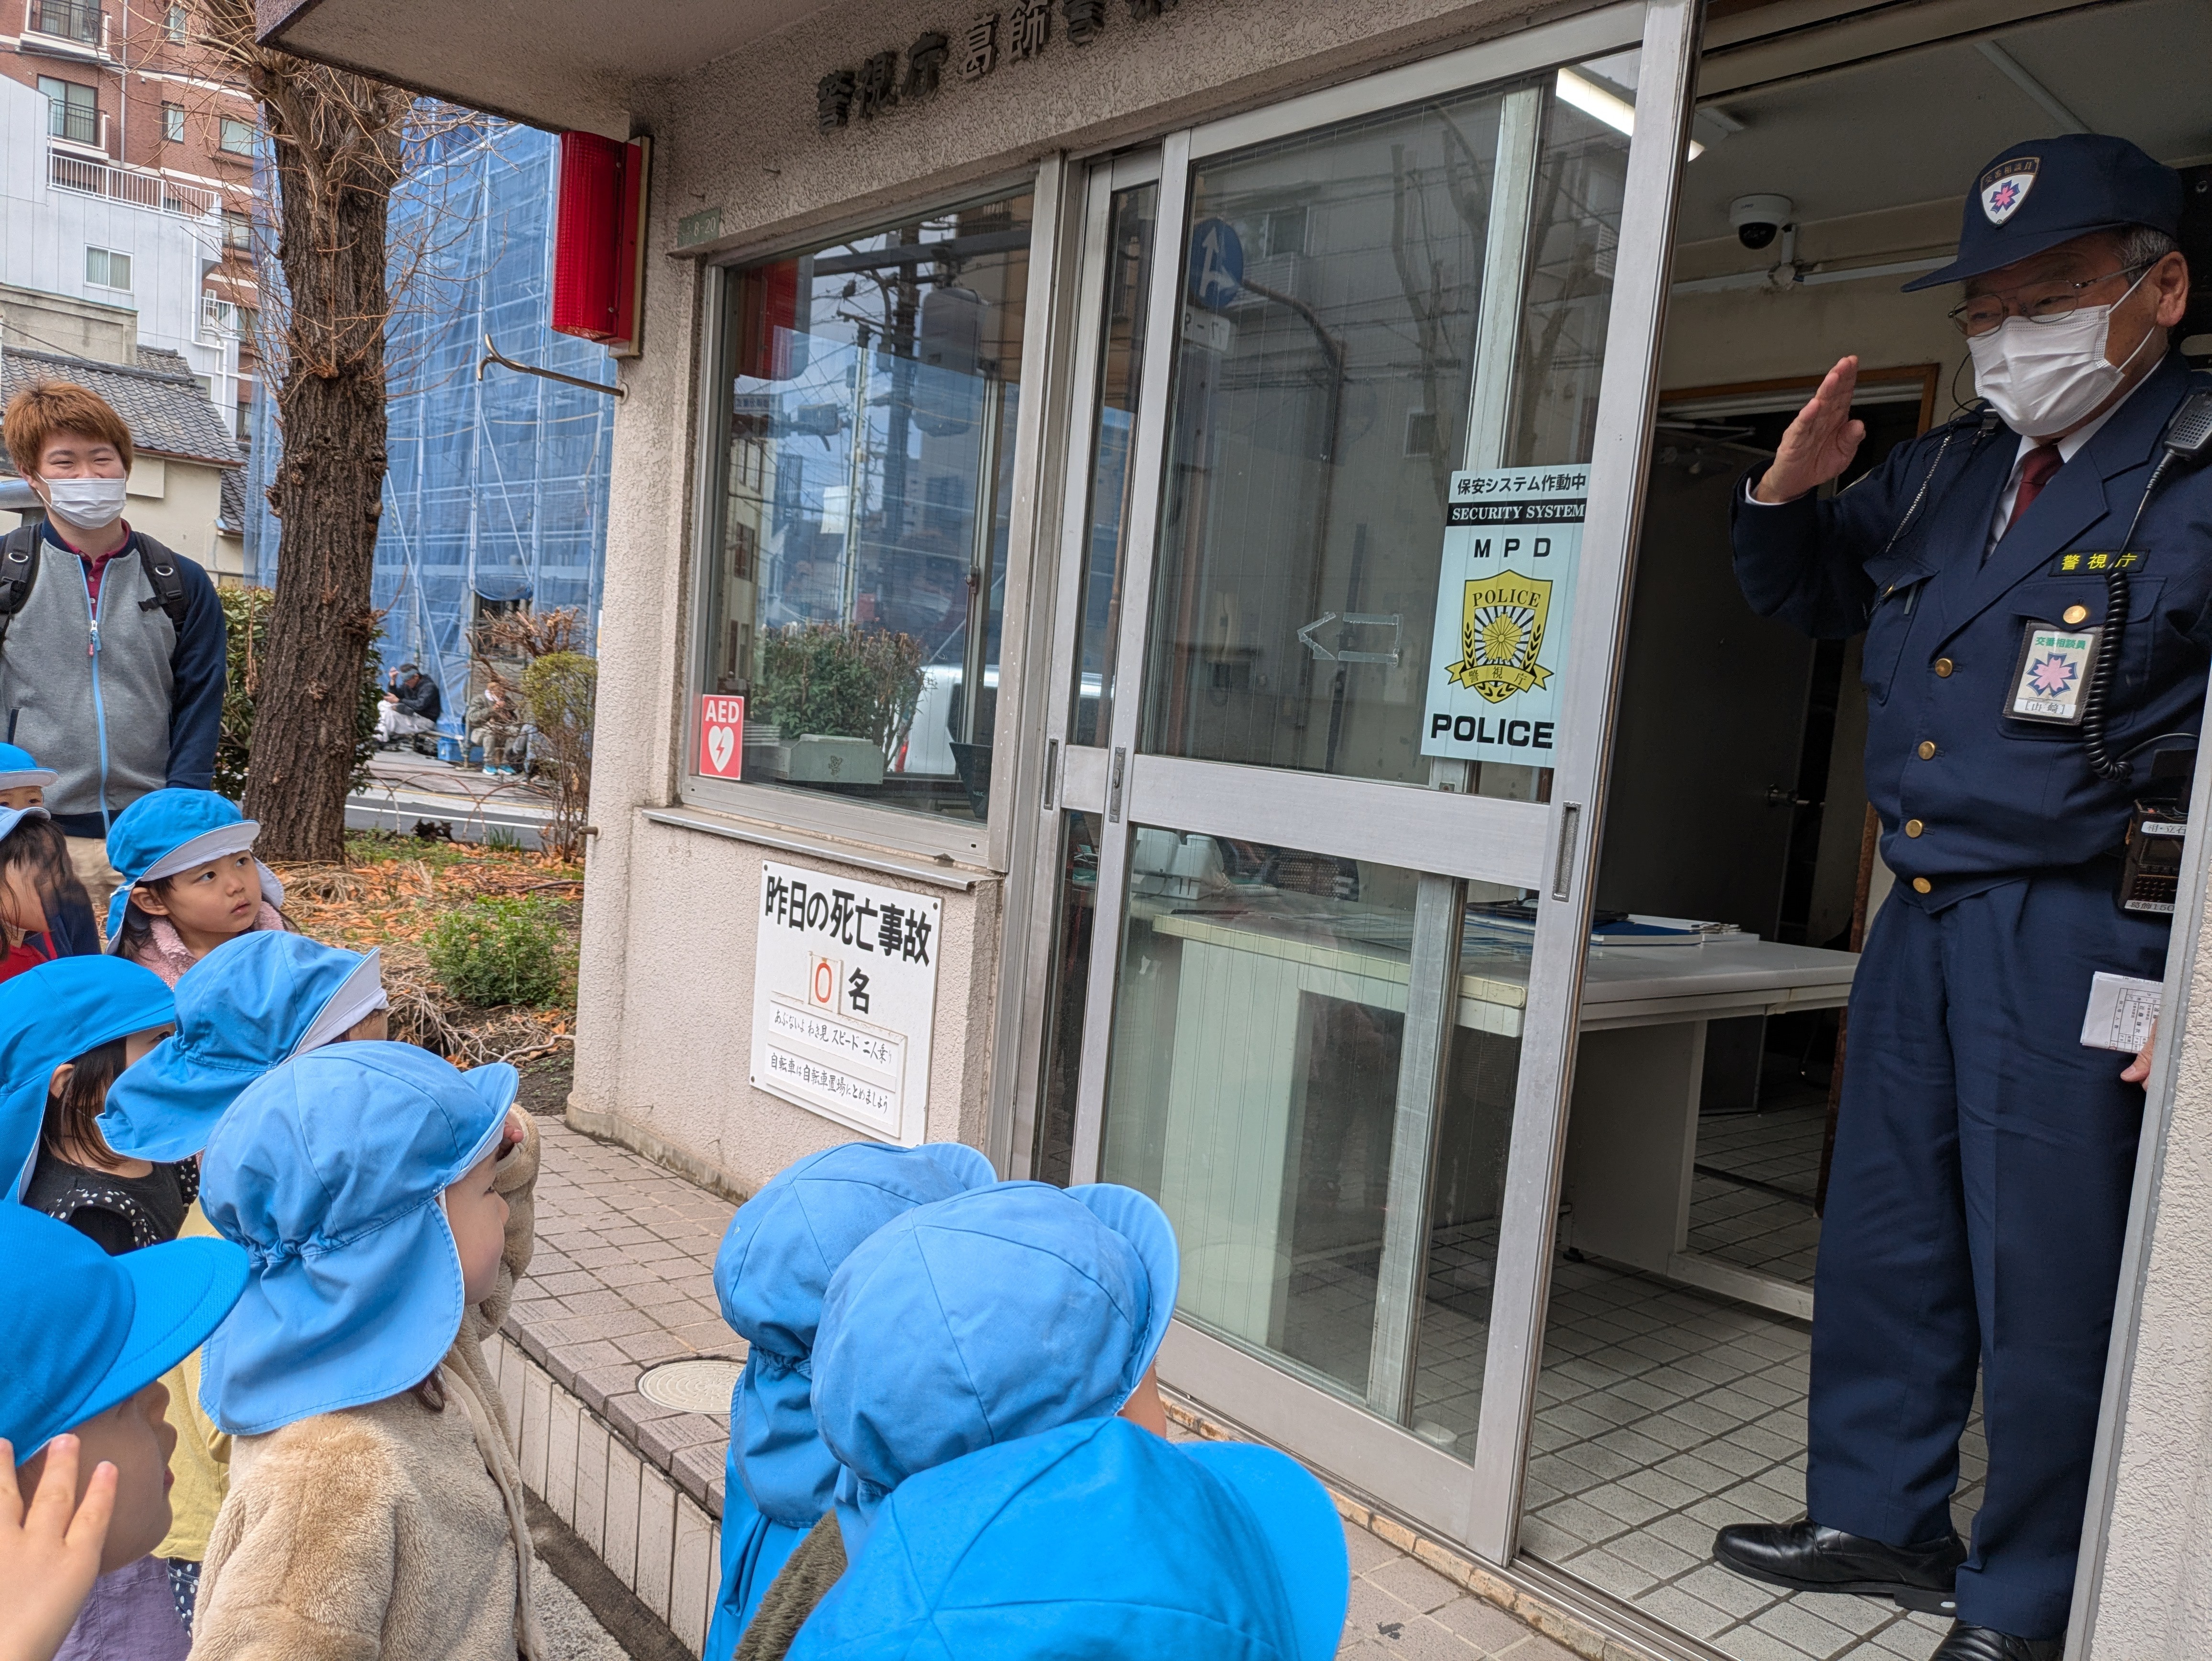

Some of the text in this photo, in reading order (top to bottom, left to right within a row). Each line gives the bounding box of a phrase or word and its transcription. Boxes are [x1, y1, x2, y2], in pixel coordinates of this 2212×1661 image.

[816, 0, 1178, 135] 警視庁葛飾警
[694, 216, 717, 237] 8-20
[1457, 473, 1586, 495] 保安システム作動中
[1452, 504, 1585, 520] SECURITY SYSTEM
[2061, 553, 2138, 571] 警視庁
[1472, 588, 1541, 608] POLICE
[2035, 636, 2086, 650] 交番相談員
[1468, 666, 1527, 686] 警視庁
[705, 699, 740, 723] AED
[1431, 713, 1555, 749] POLICE
[765, 875, 932, 967] 昨日の死亡事故
[848, 967, 870, 1015] 名
[807, 1020, 829, 1042] わき見
[831, 1030, 860, 1051] スピード
[863, 1041, 892, 1064] 二人乗り
